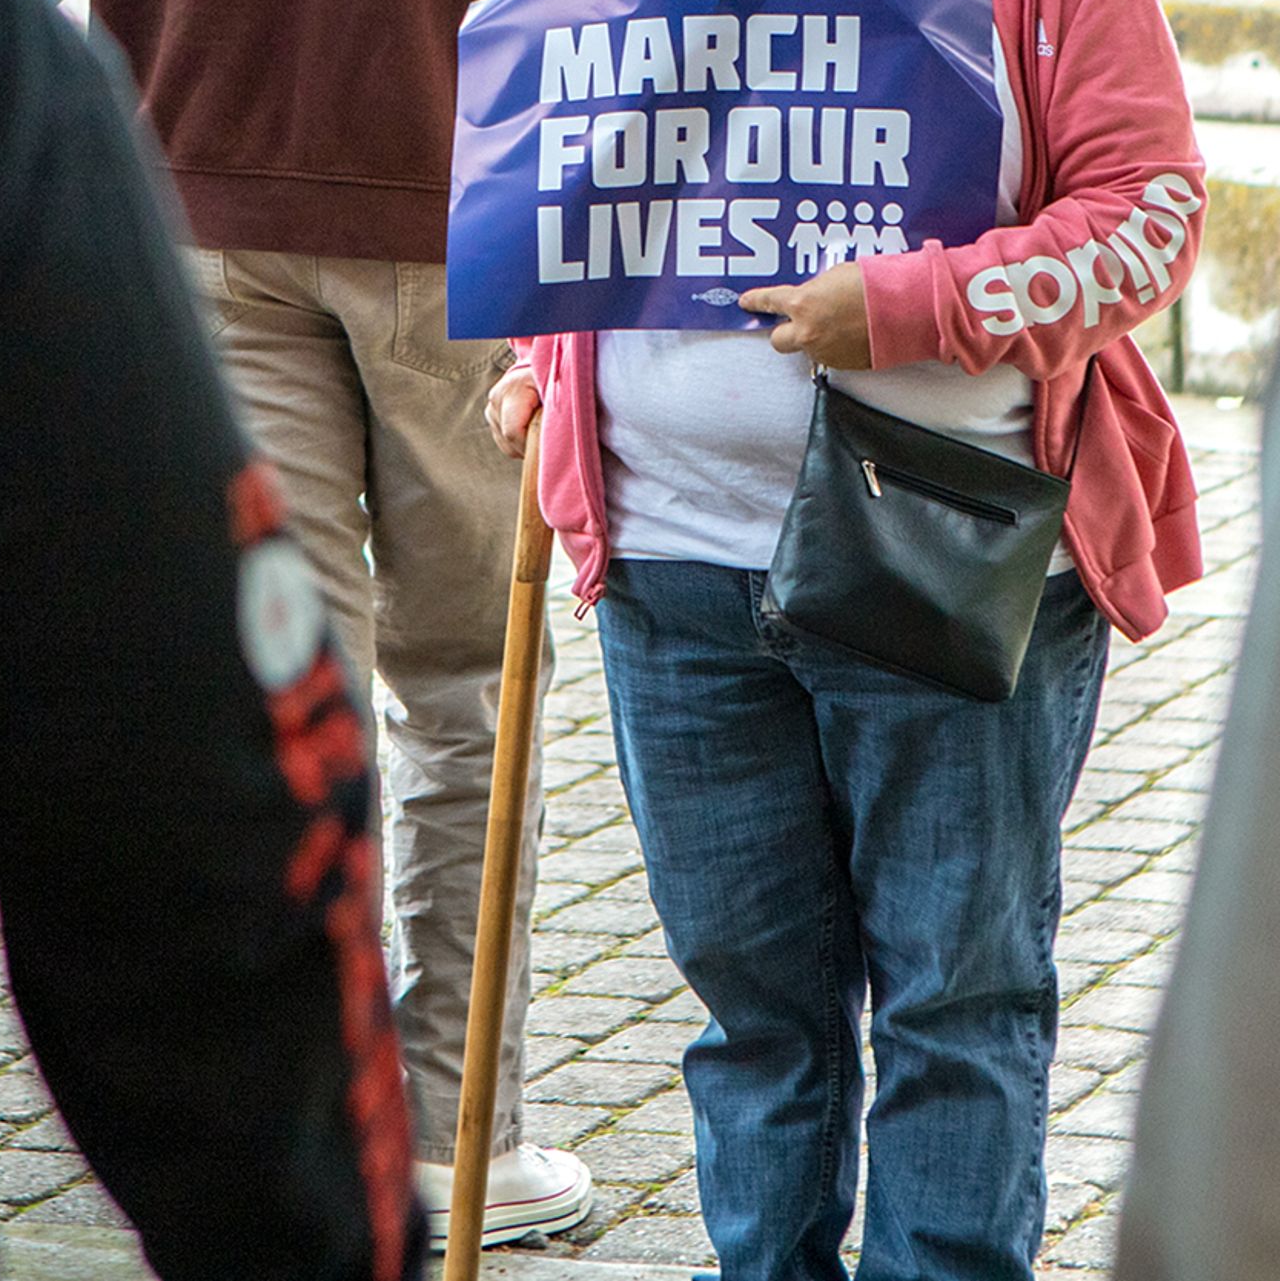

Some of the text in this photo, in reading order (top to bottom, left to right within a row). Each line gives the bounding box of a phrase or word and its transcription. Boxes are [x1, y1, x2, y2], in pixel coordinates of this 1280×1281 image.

[539, 14, 861, 103] MARCH
[537, 106, 911, 191] FOR OUR
[537, 198, 781, 284] LIVES
[966, 173, 1202, 336] adidas
